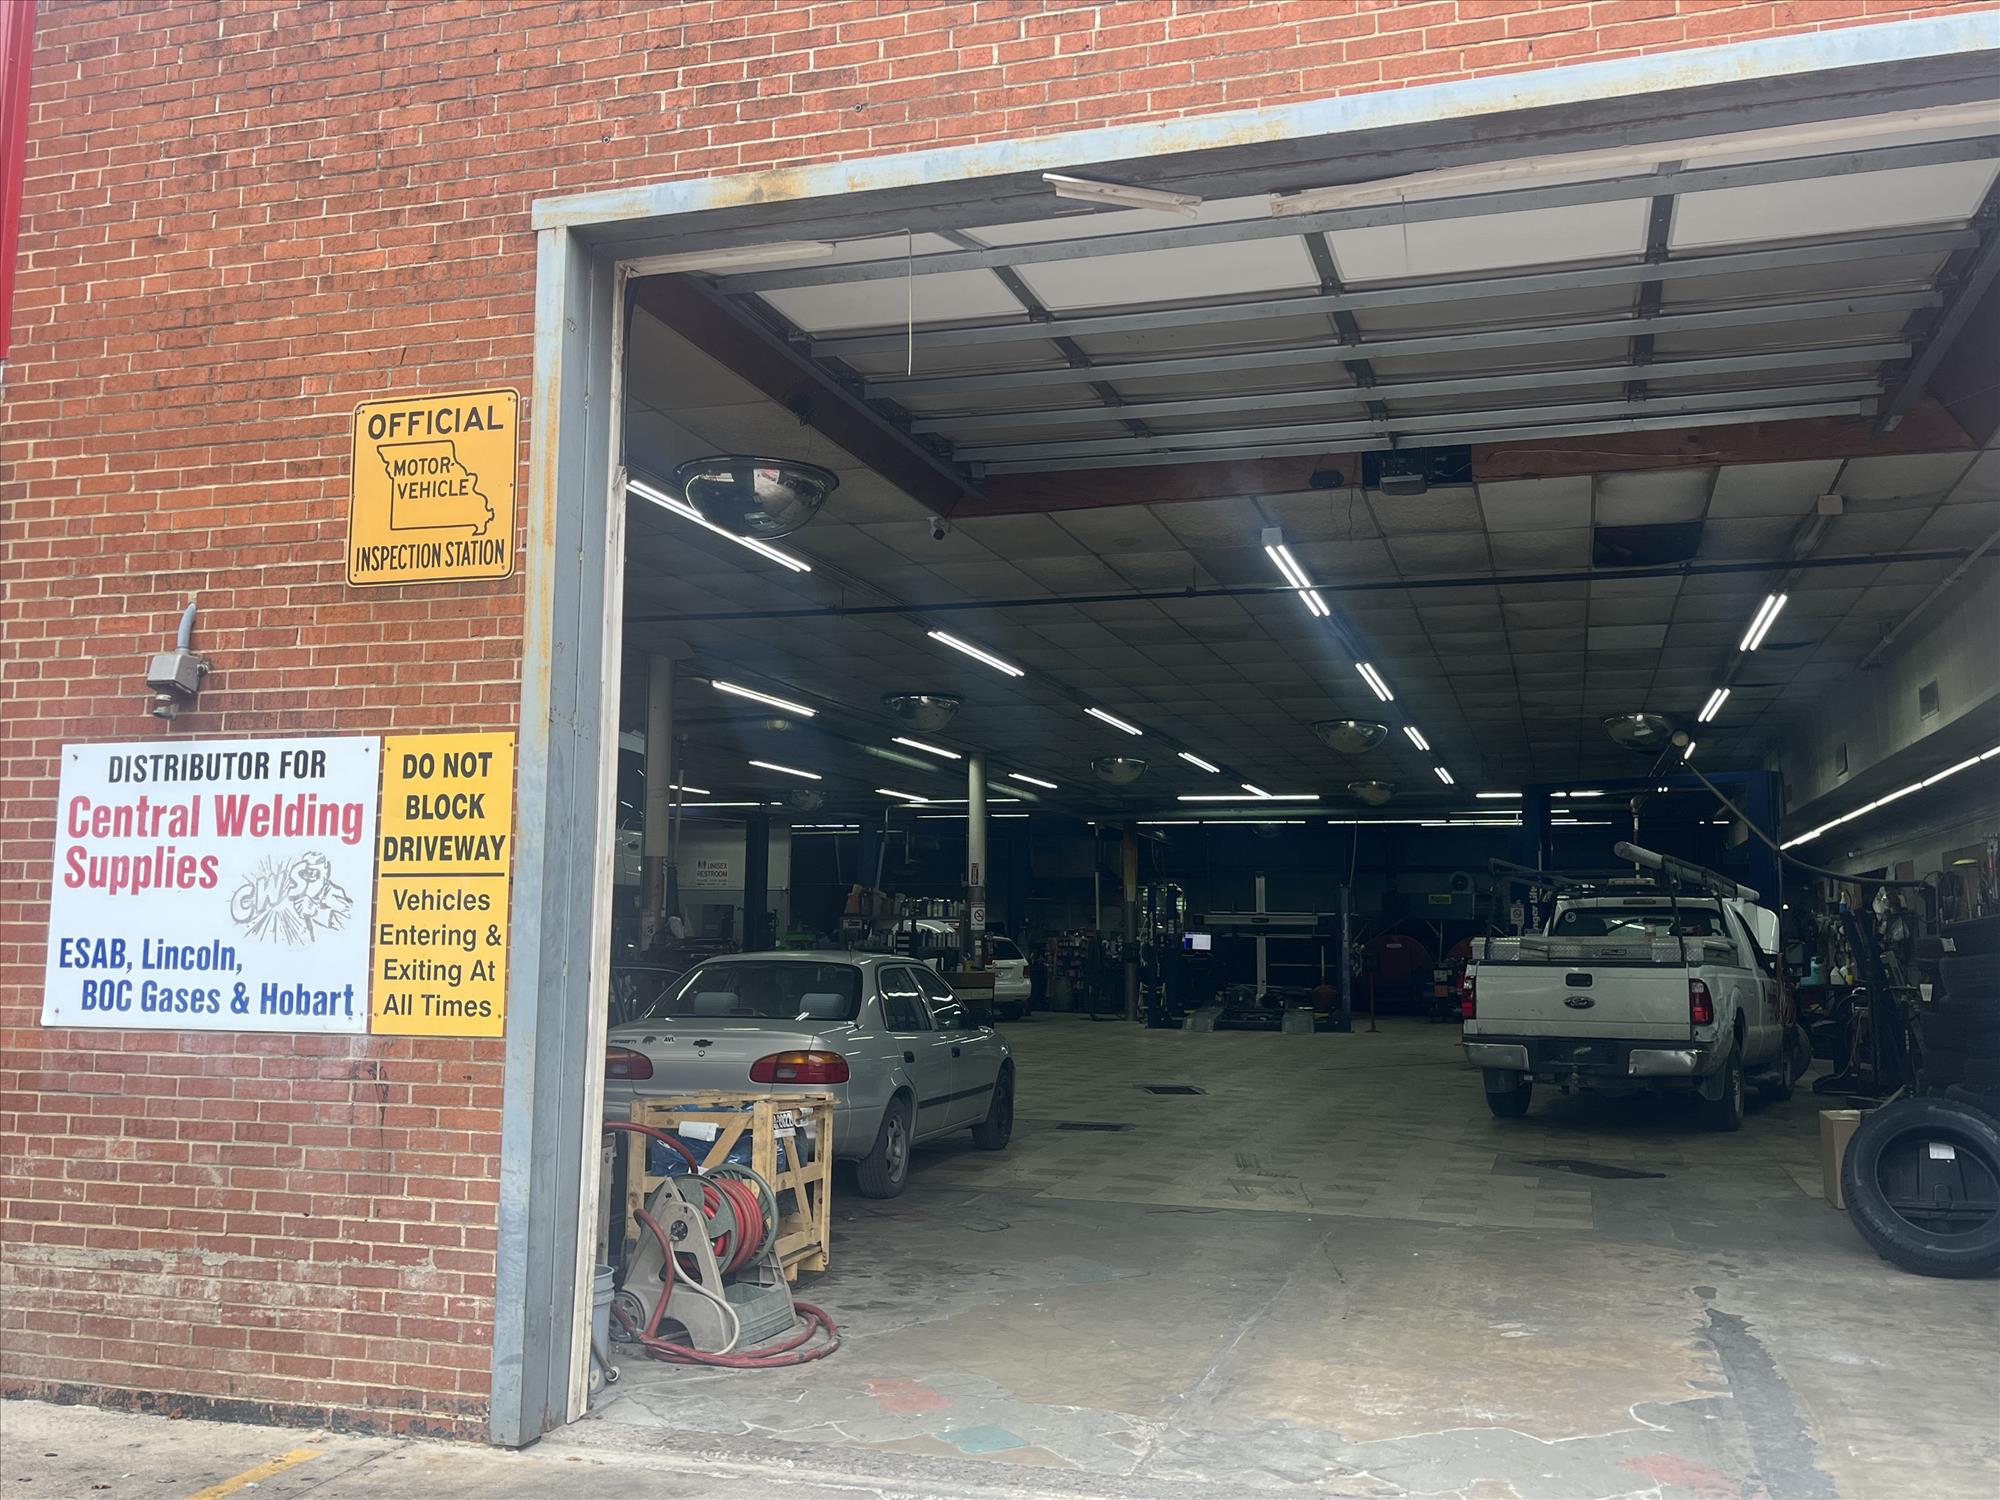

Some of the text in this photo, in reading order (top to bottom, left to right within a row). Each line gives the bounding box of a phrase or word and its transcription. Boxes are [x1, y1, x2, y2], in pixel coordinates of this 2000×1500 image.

[368, 405, 504, 440] OFFICIAL
[393, 456, 451, 476] MOTOR
[397, 478, 469, 499] VEHICLE
[355, 538, 505, 572] INSPECTION STATION
[108, 750, 326, 783] DISTRIBUTOR FOR
[402, 752, 493, 779] DO NOT
[67, 793, 364, 846] Central Welding
[405, 793, 486, 820] BLOCK
[383, 835, 506, 862] DRIVEWAY
[63, 845, 219, 895] Supplies
[393, 889, 491, 911] Vehicles
[380, 923, 502, 952] Entering &
[59, 937, 242, 976] ESAB, Lincoln,
[383, 958, 495, 987] Exiting At
[81, 979, 354, 1016] BOC Gases & Hobart
[383, 993, 492, 1017] All Times
